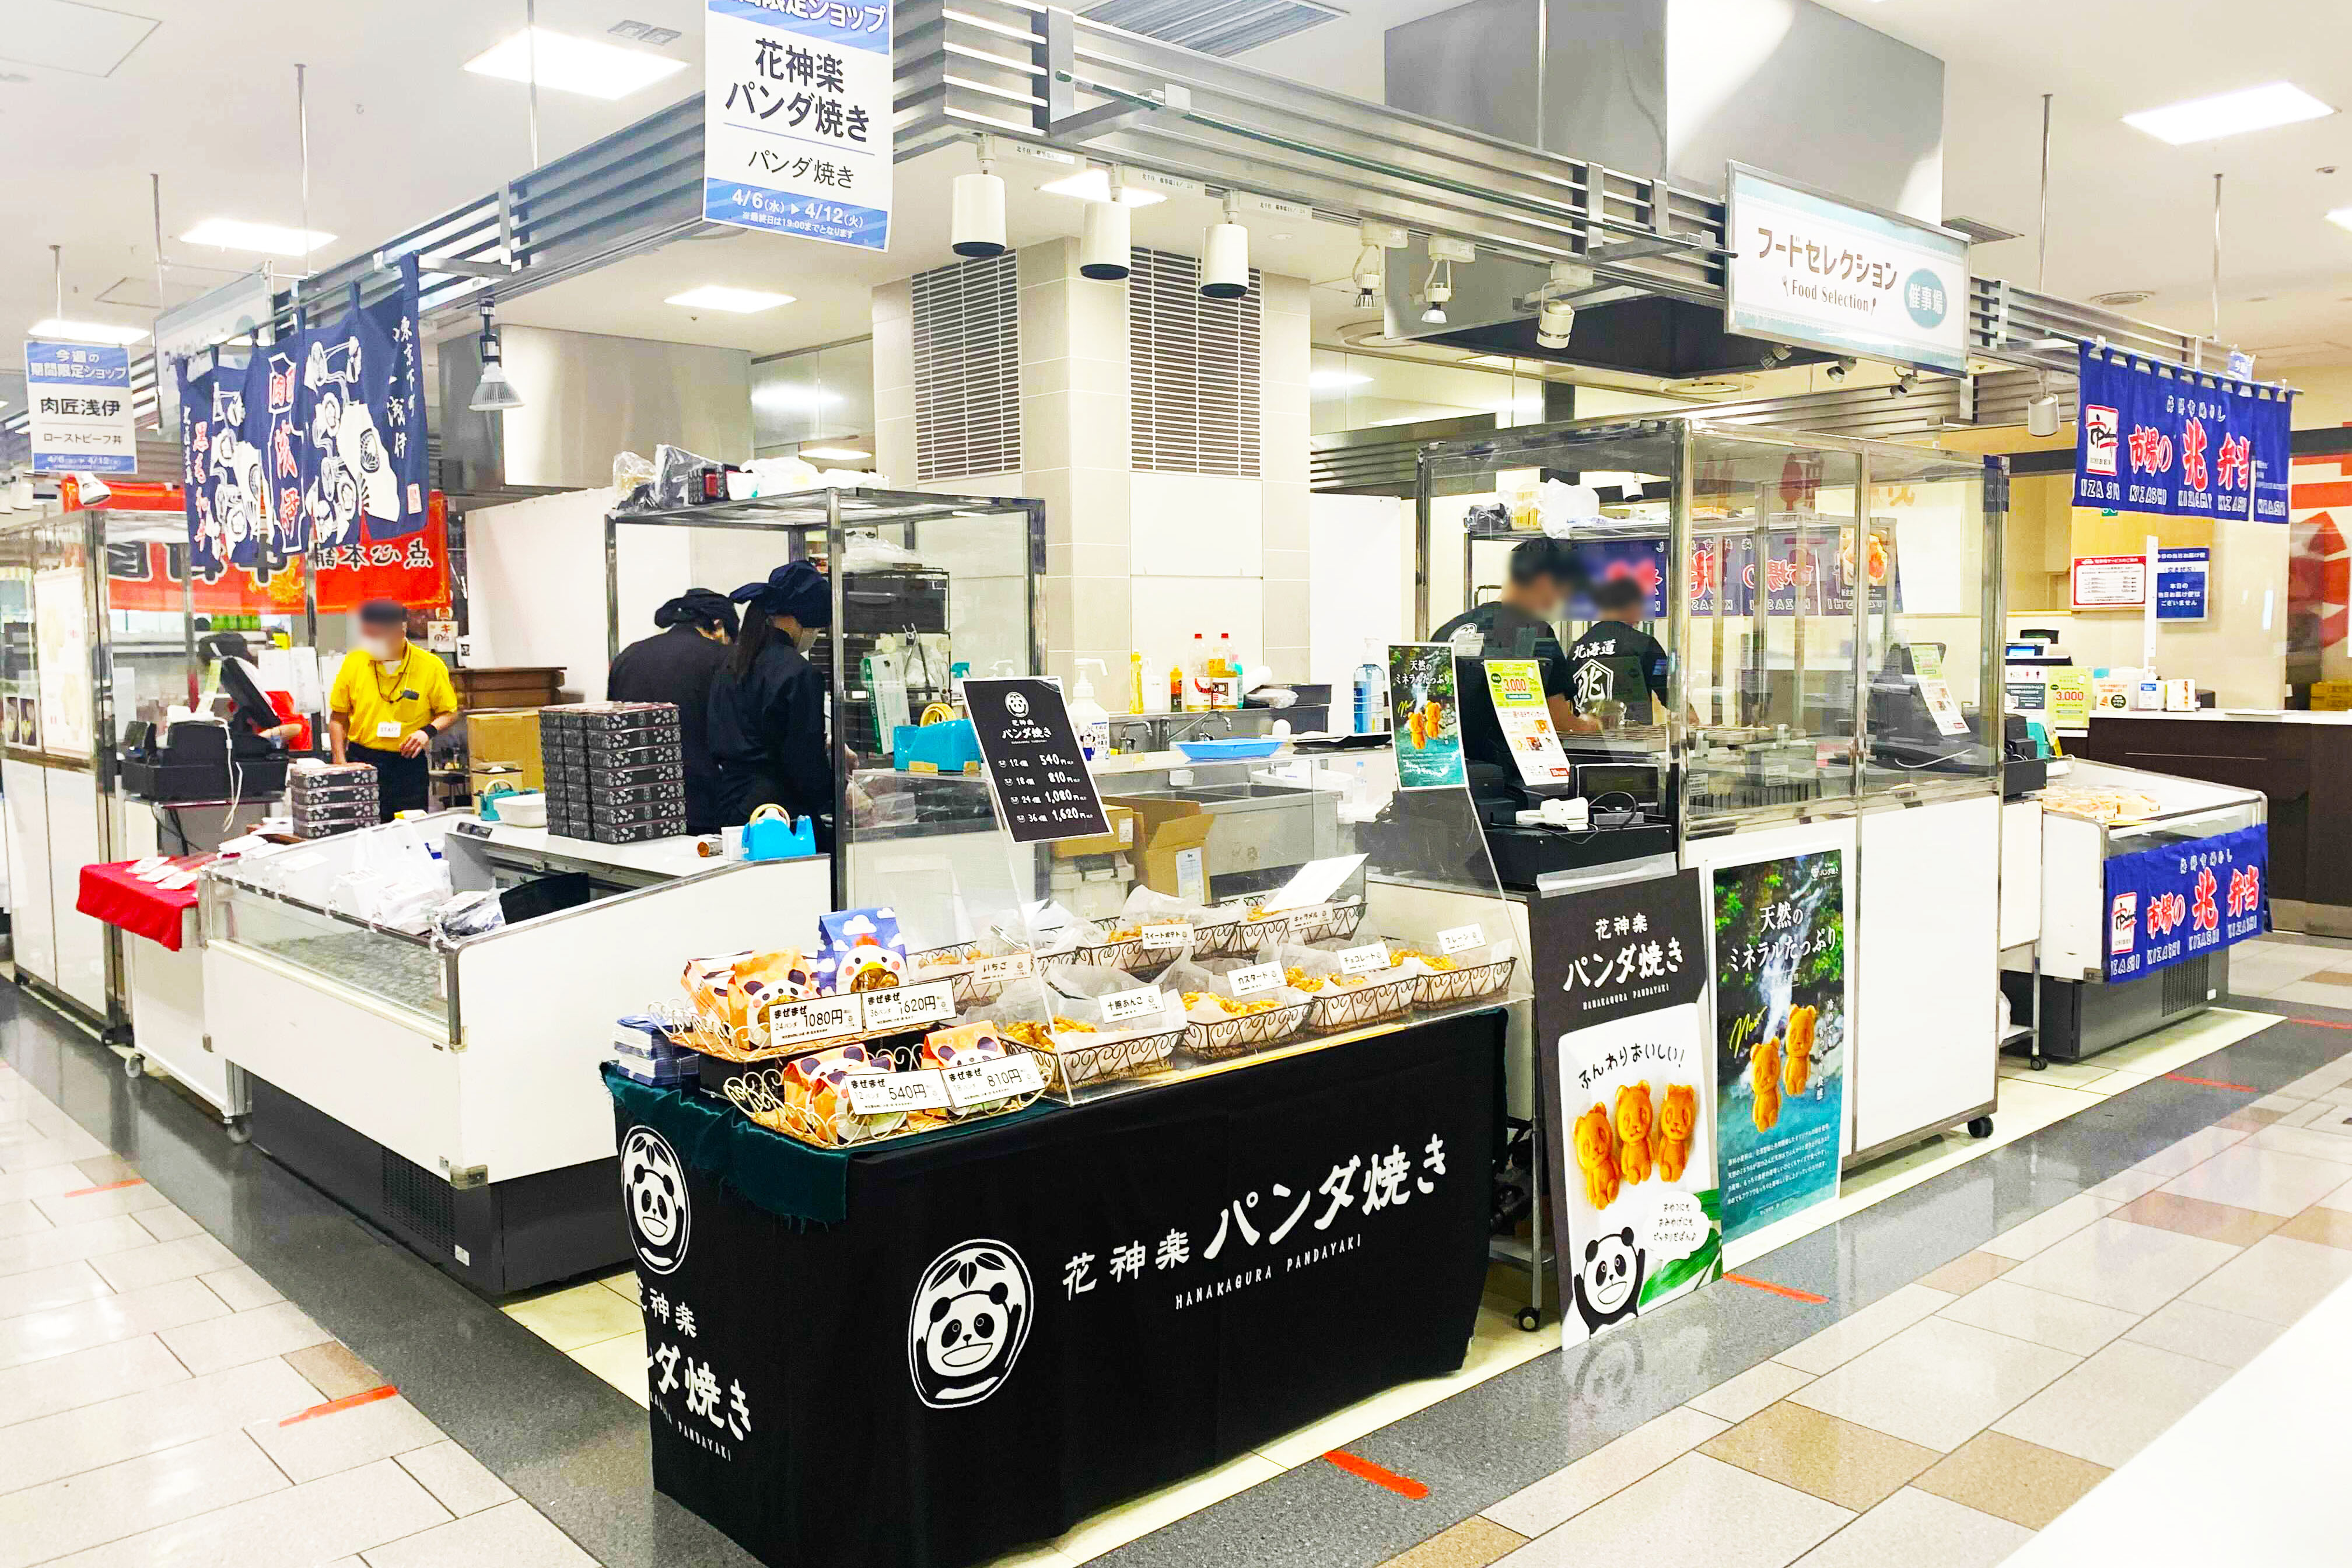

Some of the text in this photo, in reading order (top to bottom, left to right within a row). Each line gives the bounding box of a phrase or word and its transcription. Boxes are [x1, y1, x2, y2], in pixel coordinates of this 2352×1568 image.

[736, 0, 888, 33] 限定ショップ
[755, 37, 845, 93] 花神楽
[725, 81, 870, 142] パンダ焼き
[748, 150, 854, 189] パンダ焼き
[732, 188, 864, 229] 4/6(水) 4/12(火)
[1758, 227, 1898, 290] フードセレクション
[1792, 279, 1869, 313] Food Selection
[1908, 282, 1944, 316] 催事場
[56, 349, 100, 363] 今週の
[30, 362, 128, 380] 期間限定ショップ
[40, 397, 121, 416] 肉匠浅伊
[44, 433, 123, 446] ローストビーフ丼
[2128, 424, 2173, 477] 市場の
[2182, 416, 2208, 492] 兆
[2217, 432, 2251, 492] 弁当
[1573, 638, 1616, 660] 北海道
[1409, 660, 1432, 671] 天然の
[1002, 727, 1052, 740] パンダ焼き
[2147, 864, 2260, 940] 市場の 兆 弁当
[1595, 912, 1648, 941] 花神楽
[1759, 901, 1804, 933] 天然の
[1144, 931, 1180, 939] スイートポテト
[1343, 953, 1376, 964] チョコレート
[1729, 927, 1836, 972] ミネラルたっぷり
[983, 961, 1007, 972] いちご
[1563, 936, 1683, 992] パンダ焼き
[1237, 971, 1268, 985] カスタード
[867, 992, 900, 1006] まぜまぜ
[898, 995, 936, 1014] 1620円
[1107, 996, 1143, 1011] 十勝あんこ
[1583, 983, 1670, 1010] HANAKAGURA PANDAYAKI
[774, 1005, 808, 1019] まぜまぜ
[804, 1009, 843, 1027] 1080円
[851, 1079, 886, 1089] まぜまぜ
[949, 1068, 982, 1082] まぜまぜ
[986, 1069, 1022, 1087] 810円
[888, 1084, 927, 1100] 540円
[1063, 1133, 1446, 1301] 花神楽 パンダ焼き
[1663, 1203, 1691, 1212] おやつにも
[1175, 1234, 1362, 1310] HANAKAGURA PANDAYAKI
[646, 1341, 752, 1442] ダ焼き
[677, 1420, 732, 1462] PANDAYAKI
